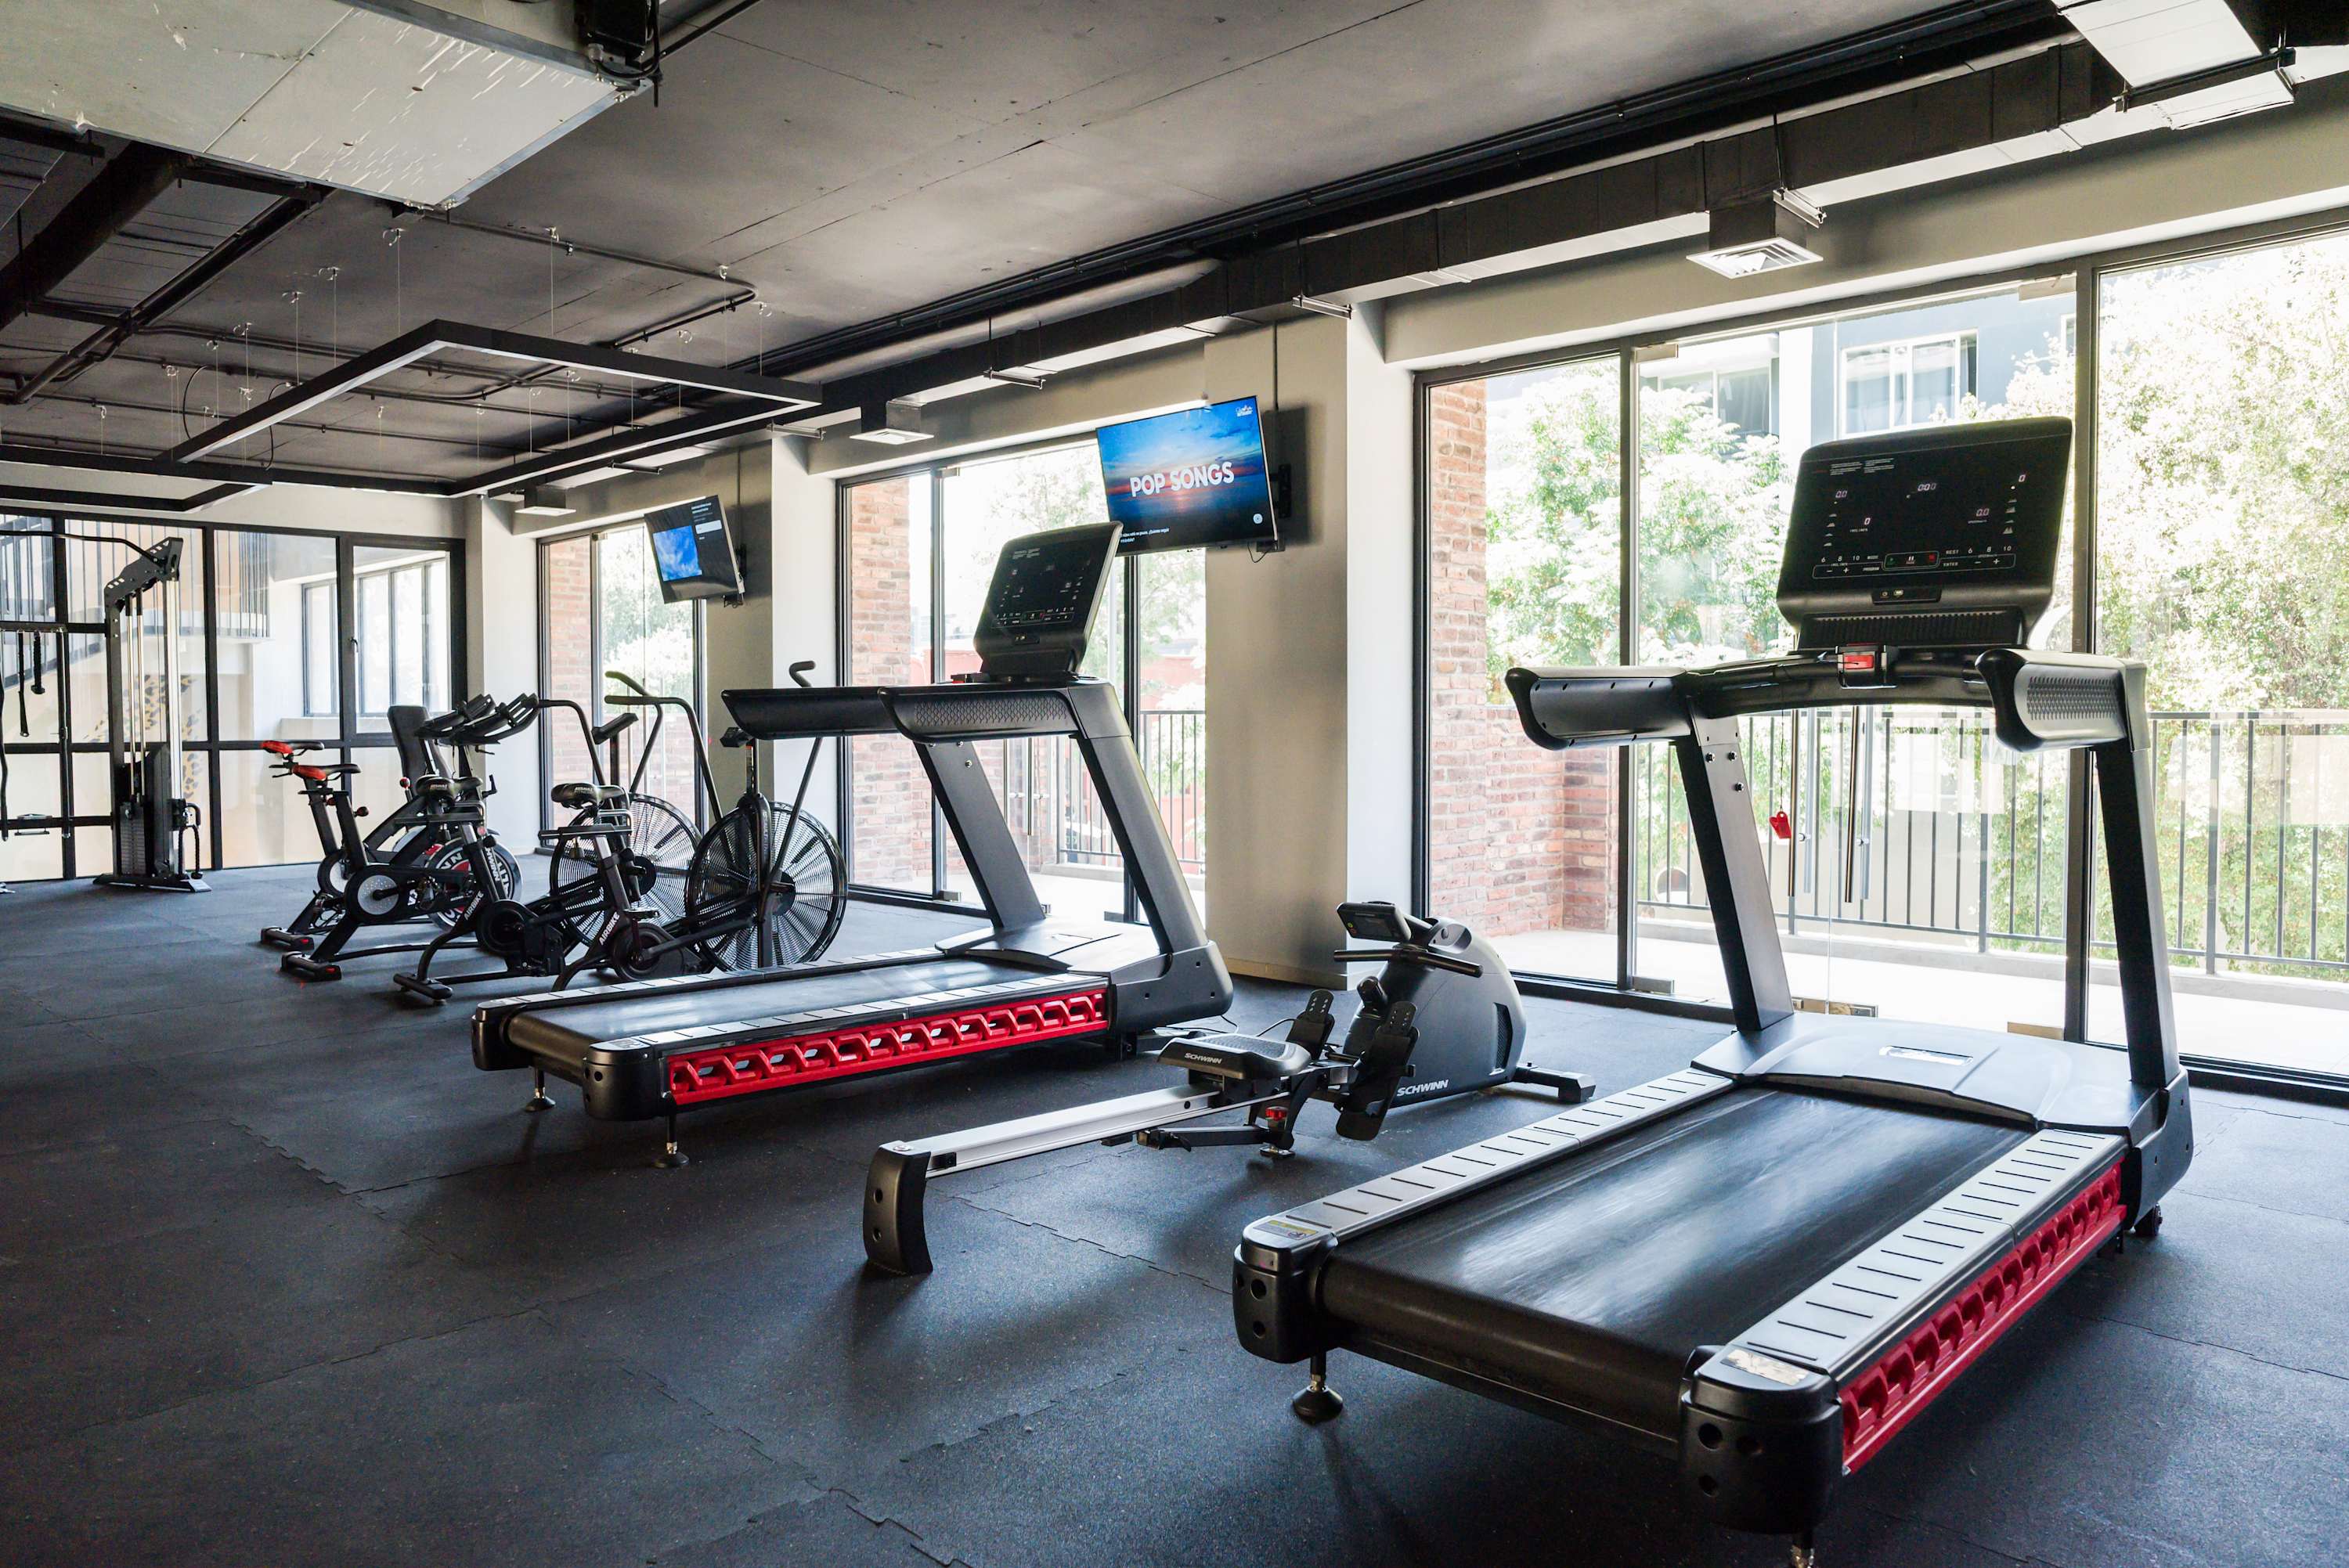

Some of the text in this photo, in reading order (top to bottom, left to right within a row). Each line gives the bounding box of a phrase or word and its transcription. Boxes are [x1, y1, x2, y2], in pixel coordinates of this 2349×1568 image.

[1130, 461, 1235, 497] POP SONGS
[464, 890, 484, 921] AIRBIKE
[599, 911, 619, 946] AIRBIKE
[1184, 1052, 1222, 1064] SCHWINN
[1396, 1079, 1449, 1097] SCHWINN
